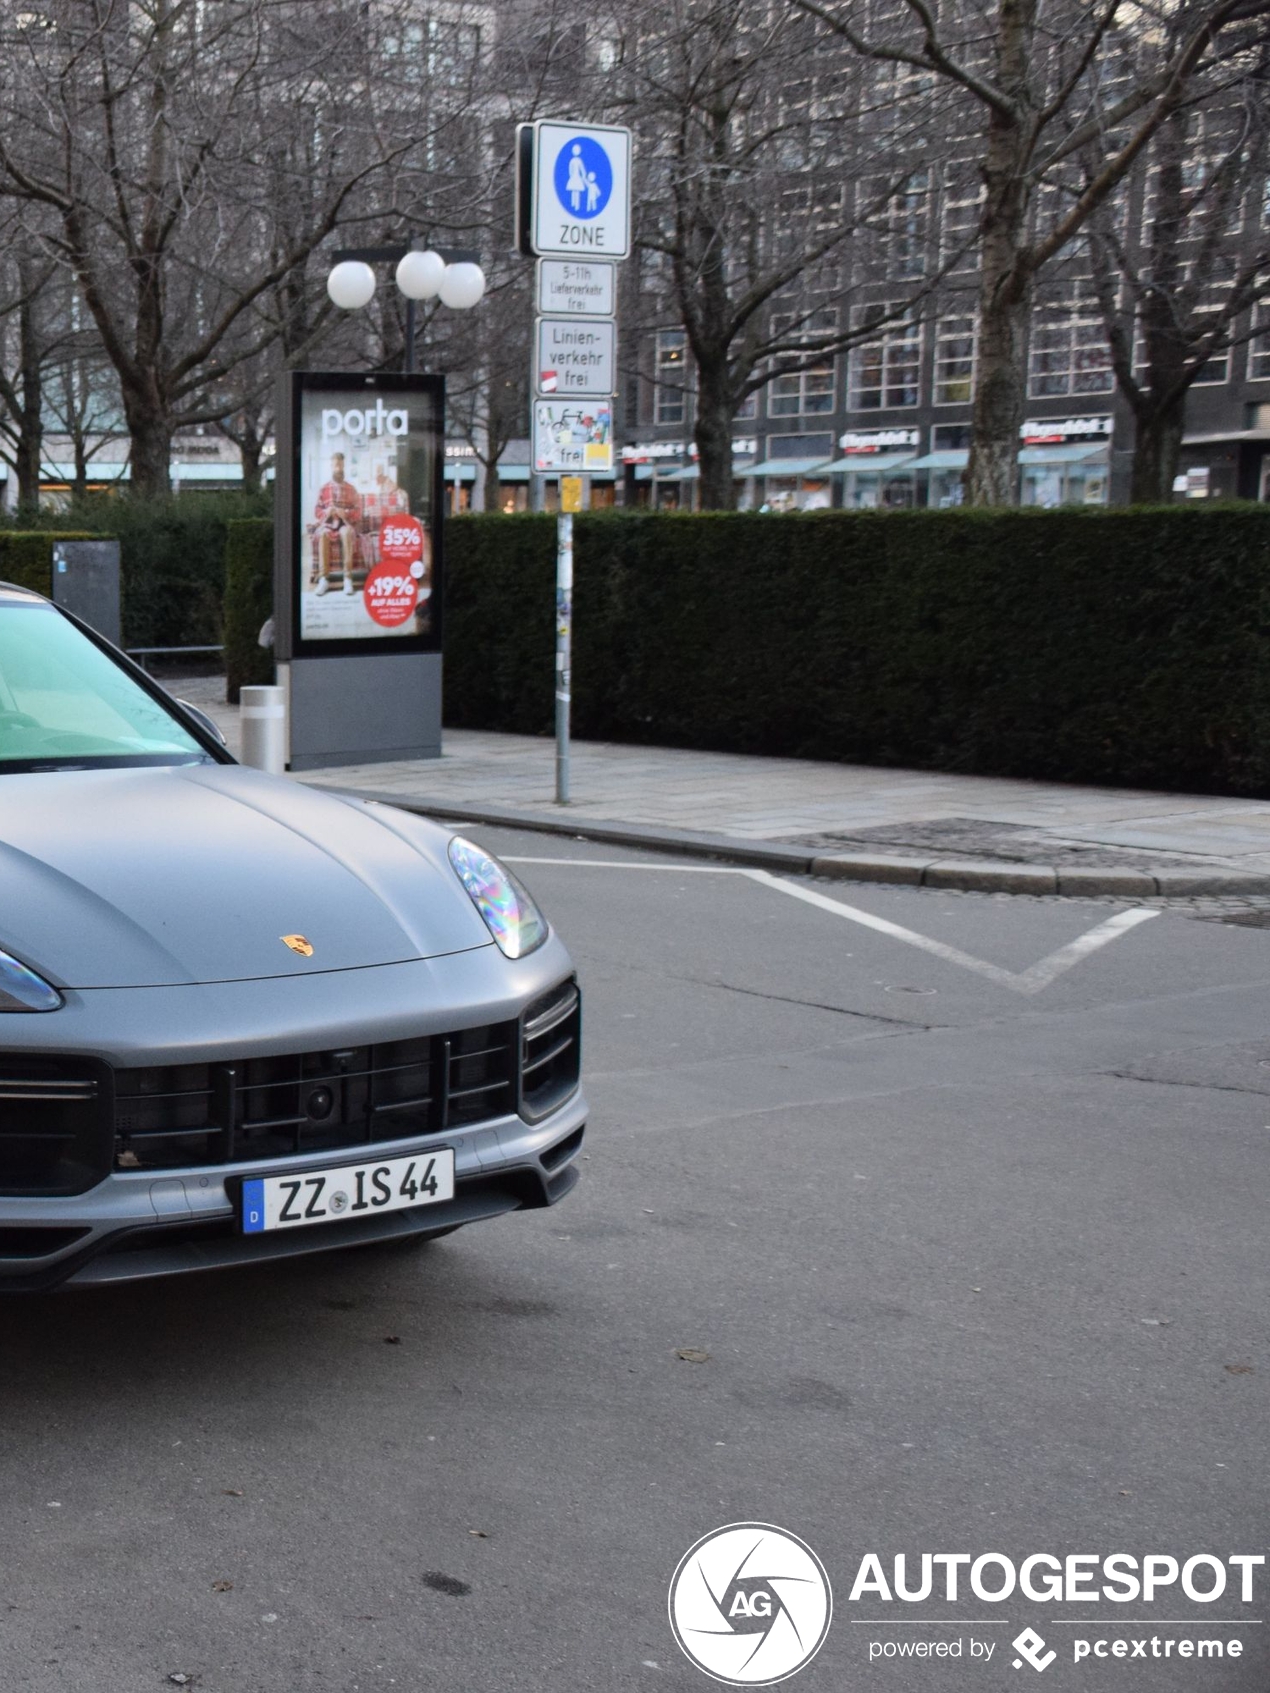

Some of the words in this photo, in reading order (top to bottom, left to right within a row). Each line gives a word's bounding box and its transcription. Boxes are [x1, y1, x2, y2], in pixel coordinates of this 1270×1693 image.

[559, 225, 605, 246] ZONE
[550, 282, 603, 296] Lieferverkehr
[568, 298, 586, 310] frei
[552, 328, 601, 345] Linien-
[550, 350, 604, 366] verkehr
[565, 370, 589, 386] frei
[322, 398, 409, 444] porta
[561, 448, 584, 463] frei
[383, 528, 421, 546] 35%
[368, 576, 415, 596] +19%
[279, 1177, 326, 1222] ZZ
[351, 1167, 391, 1211] IS
[399, 1158, 438, 1200] 44
[249, 1211, 259, 1224] D
